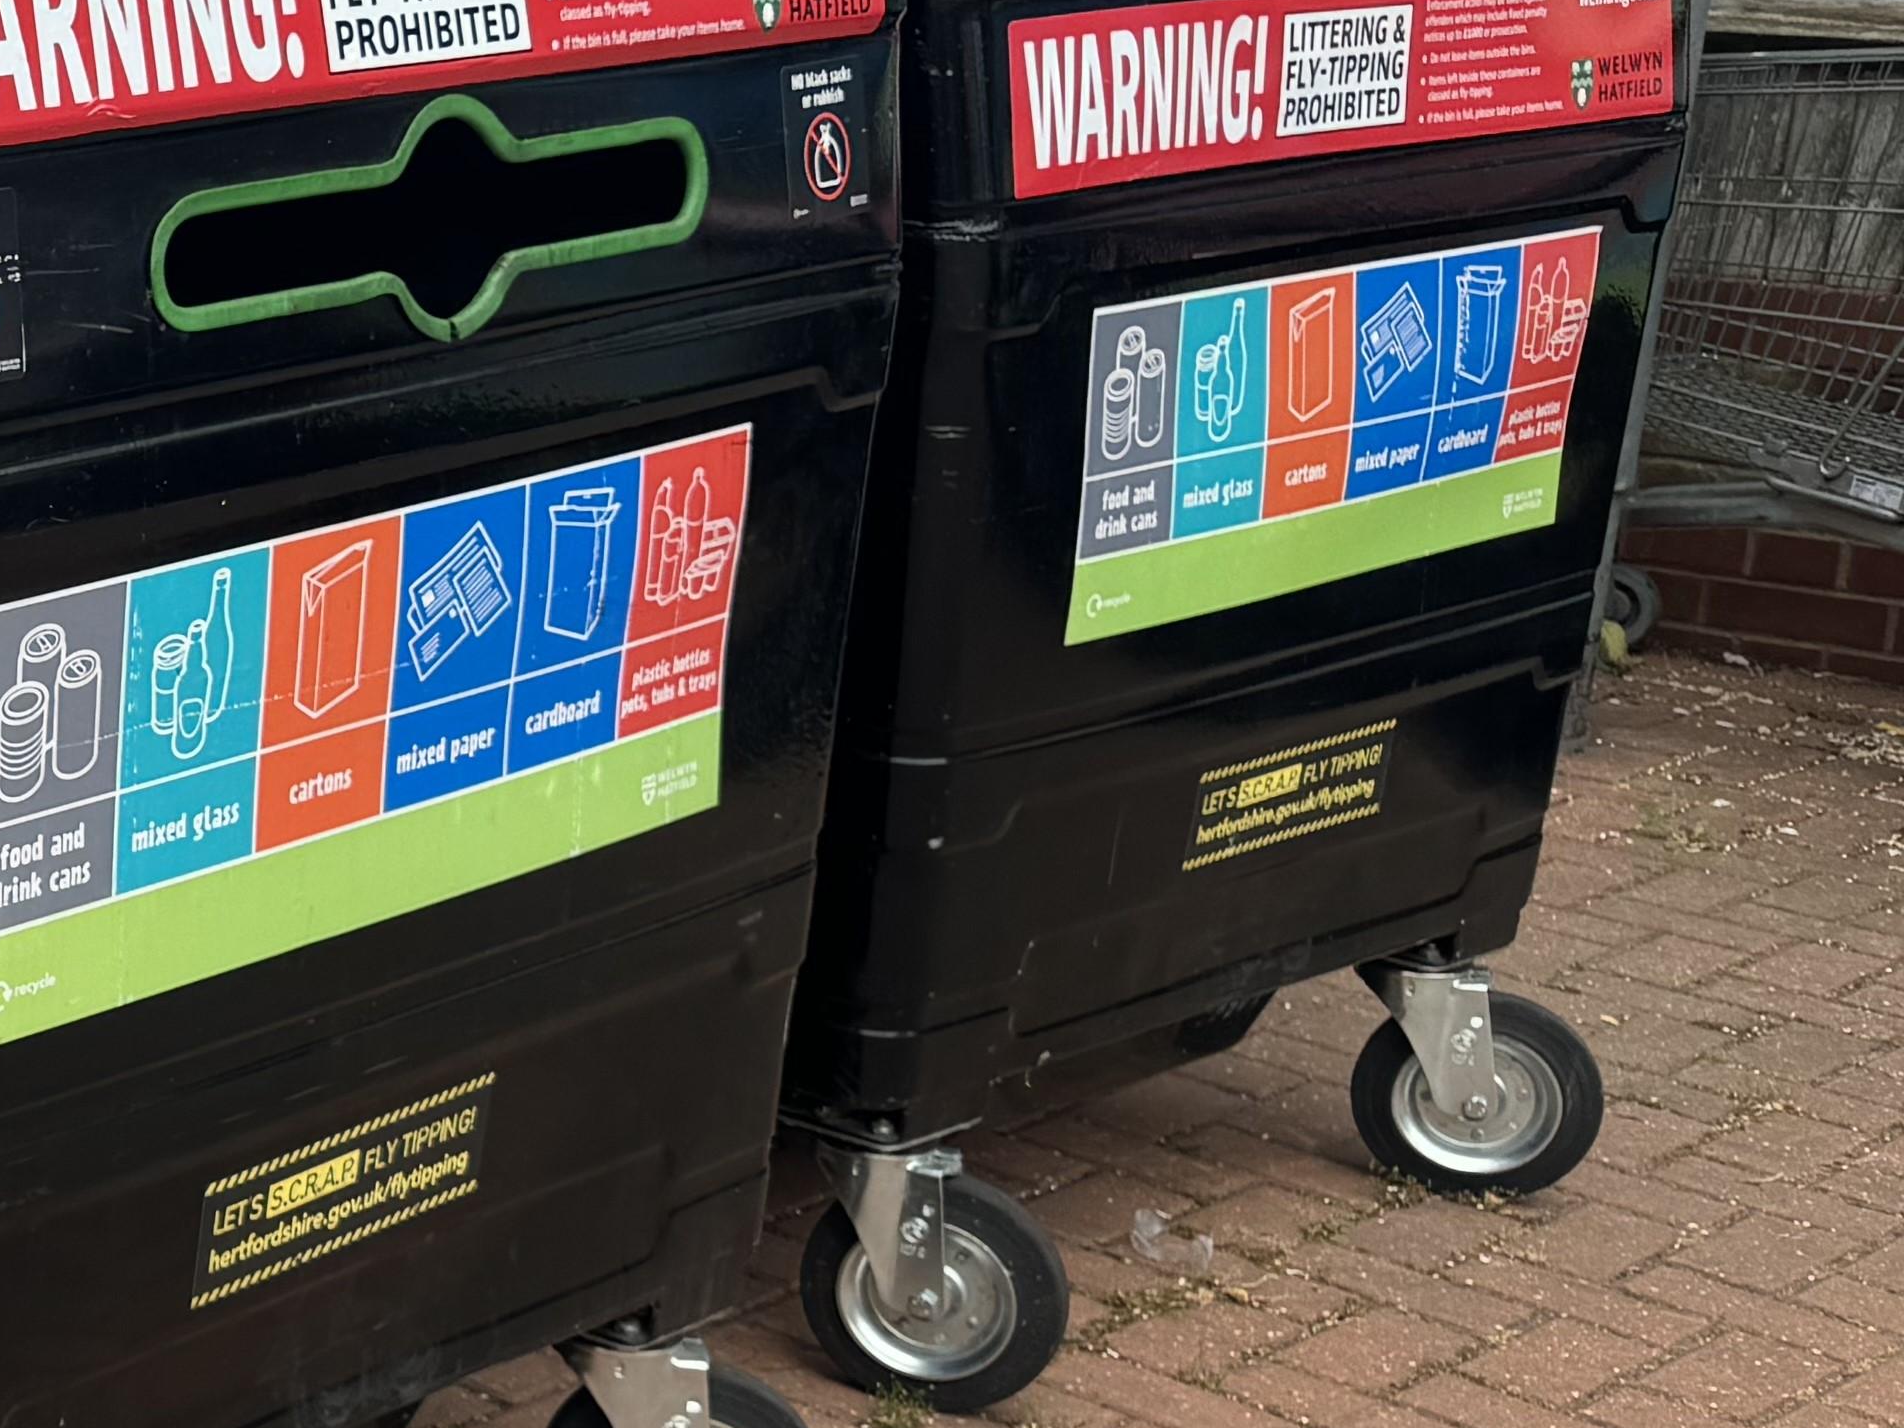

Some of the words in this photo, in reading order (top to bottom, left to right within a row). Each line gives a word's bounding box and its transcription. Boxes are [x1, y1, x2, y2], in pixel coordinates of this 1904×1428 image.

[335, 3, 520, 61] PROHIBITED
[1289, 15, 1389, 53] LITTERING
[1393, 15, 1406, 44] &
[1285, 51, 1404, 90] FLY-TIPPING
[1598, 51, 1663, 77] WELWYN
[1024, 14, 1269, 170] WARNING!
[1283, 87, 1401, 128] PROHIBITED
[1599, 77, 1663, 103] HATFIELD
[1438, 424, 1489, 454] cardboard
[1285, 463, 1328, 487] cartons
[1355, 447, 1389, 473] mixed
[1389, 444, 1420, 469] paper
[1102, 485, 1130, 512] food
[1133, 480, 1156, 505] and
[1183, 482, 1220, 509] mixed
[1222, 479, 1254, 506] glass
[1095, 513, 1127, 540] drink
[1131, 511, 1158, 532] cans
[525, 690, 601, 735] cardboard
[396, 737, 447, 775] mixed
[450, 728, 496, 764] paper
[289, 769, 353, 805] cartons
[0, 834, 44, 871] food
[51, 822, 85, 857] and
[132, 813, 187, 853] mixed
[193, 803, 240, 842] glass
[50, 861, 91, 892] cans
[213, 1193, 265, 1236] LET'S
[363, 1139, 399, 1174] FLY
[402, 1106, 477, 1158] TIPPING!
[209, 1151, 469, 1274] hertfordshire.gov.uk/flytipping
